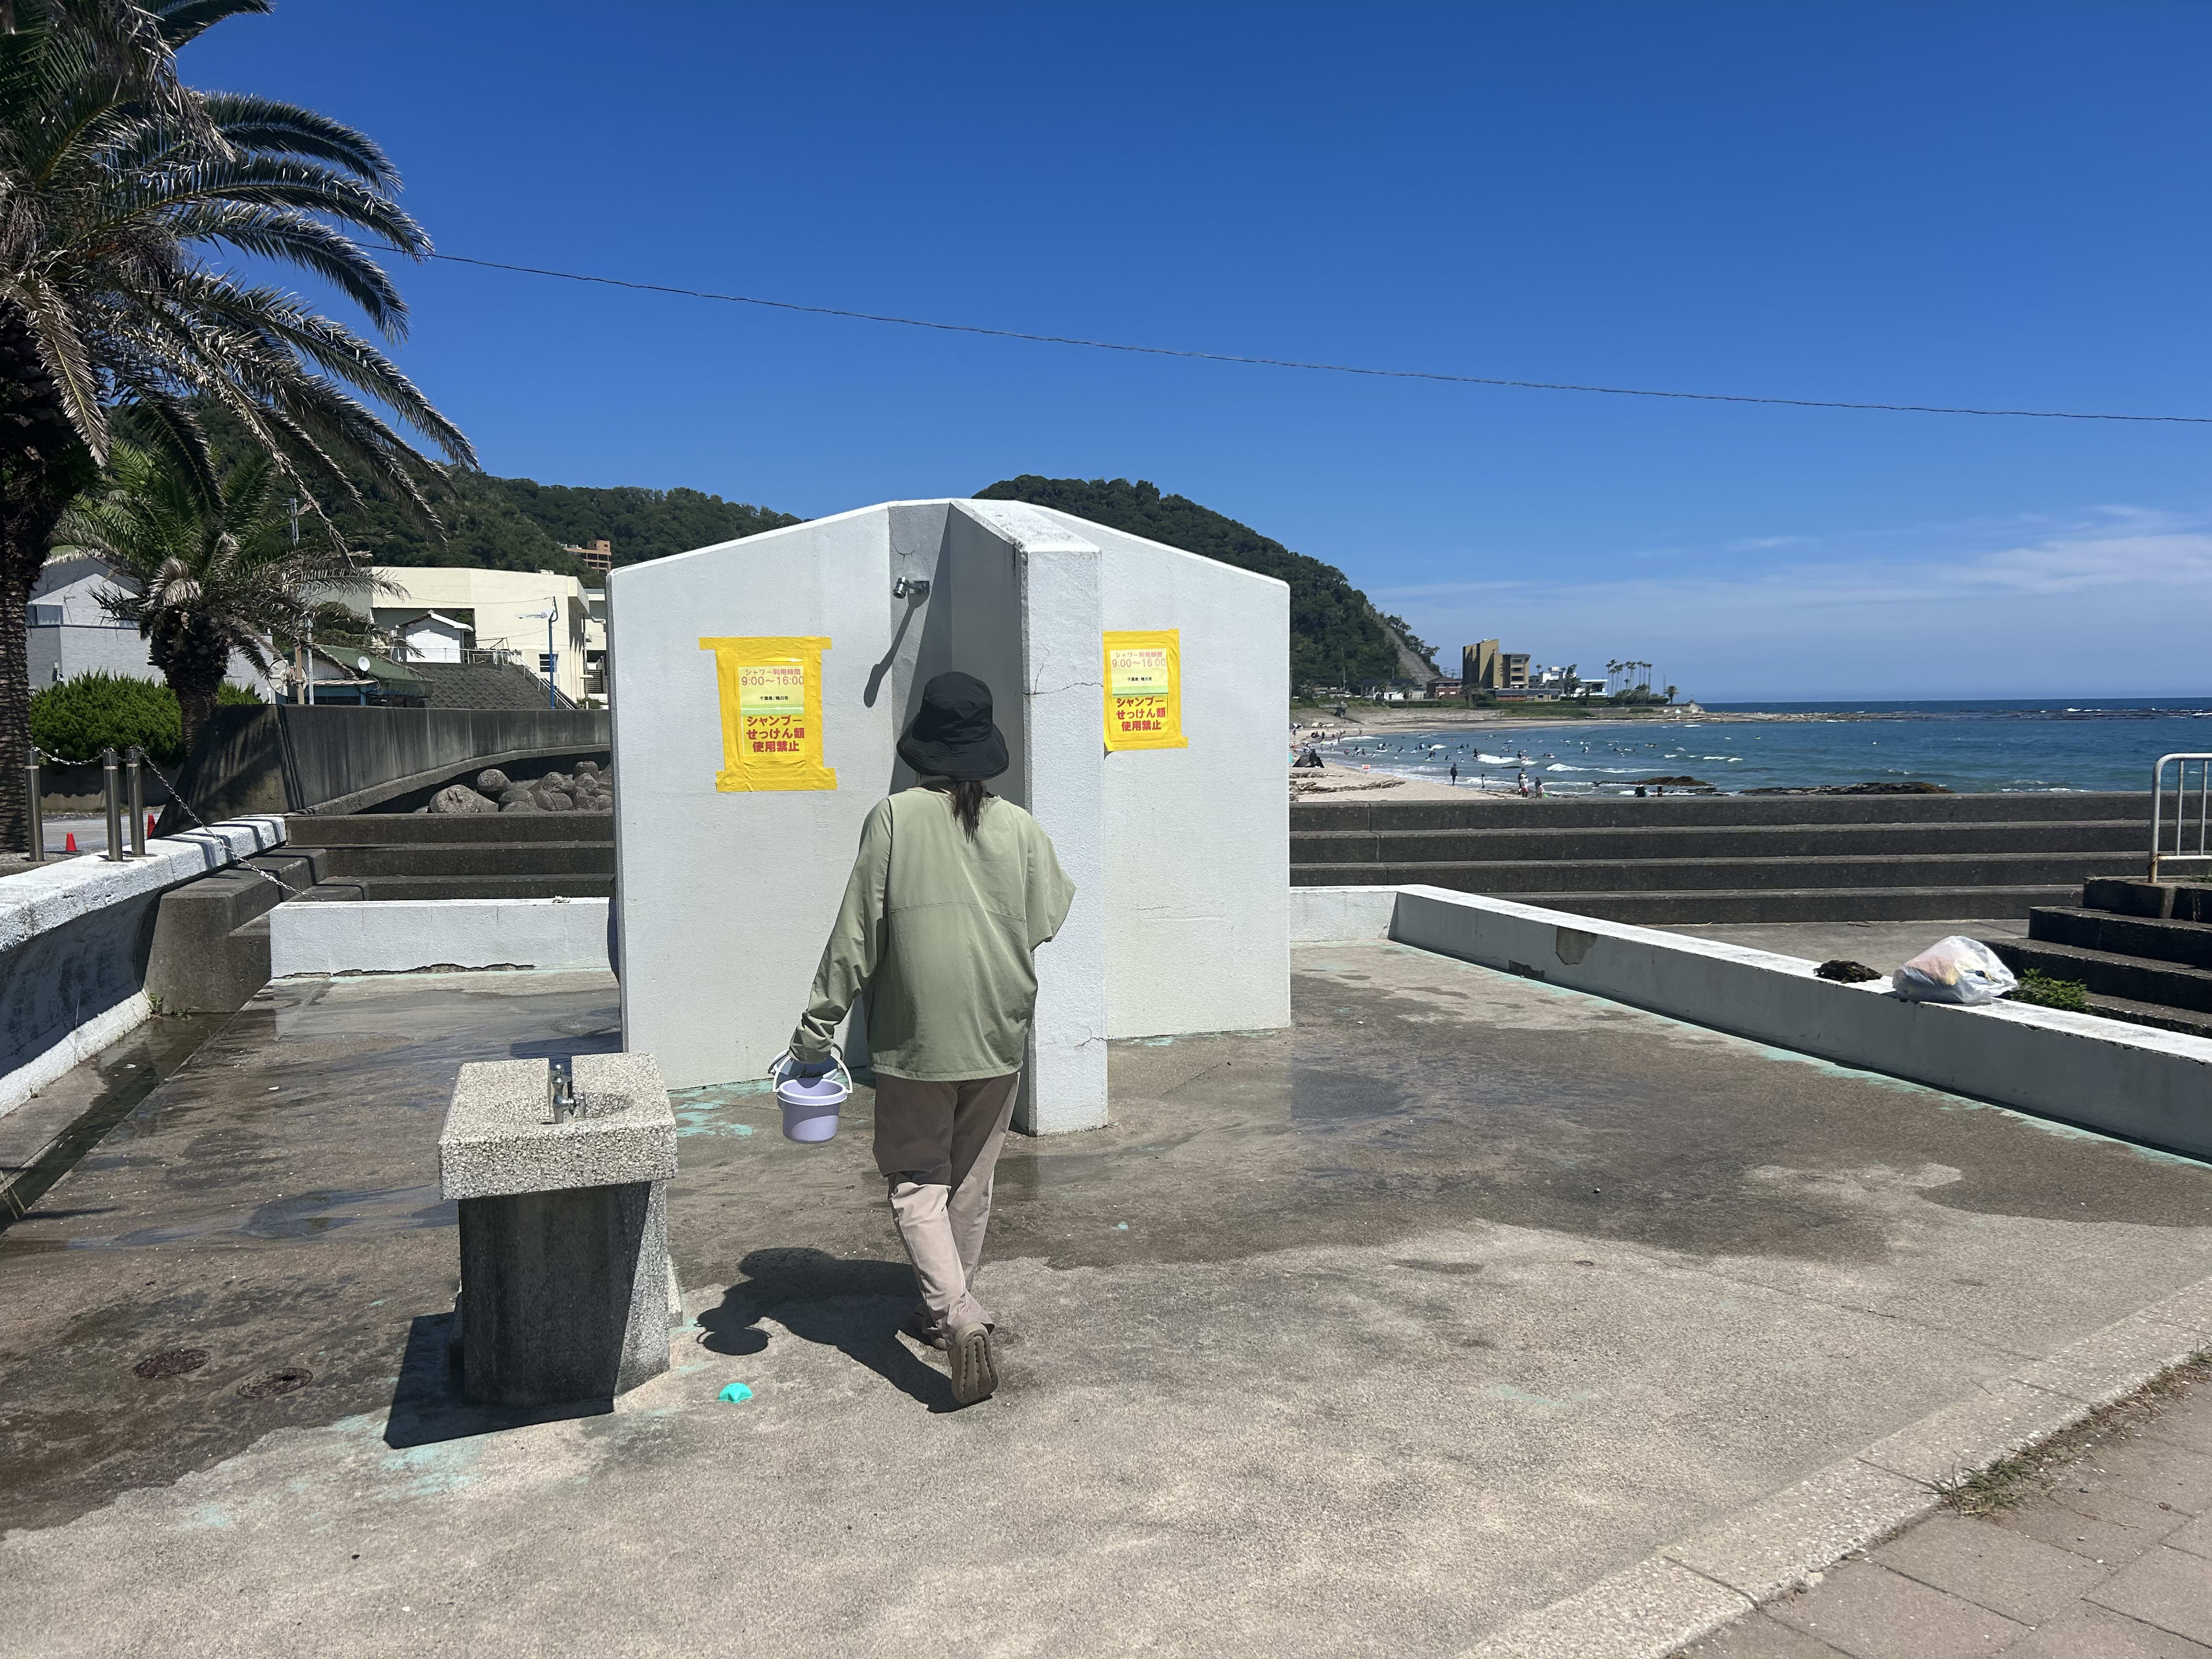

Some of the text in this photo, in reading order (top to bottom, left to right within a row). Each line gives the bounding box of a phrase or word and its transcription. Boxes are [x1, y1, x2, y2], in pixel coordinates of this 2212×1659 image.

[1116, 696, 1164, 708] シャンプー
[1116, 707, 1166, 720] せっけん類
[747, 715, 802, 727] シャンプー
[1121, 719, 1161, 732] 使用禁止
[747, 727, 805, 740] せっけん類
[753, 740, 800, 753] 使用禁止
